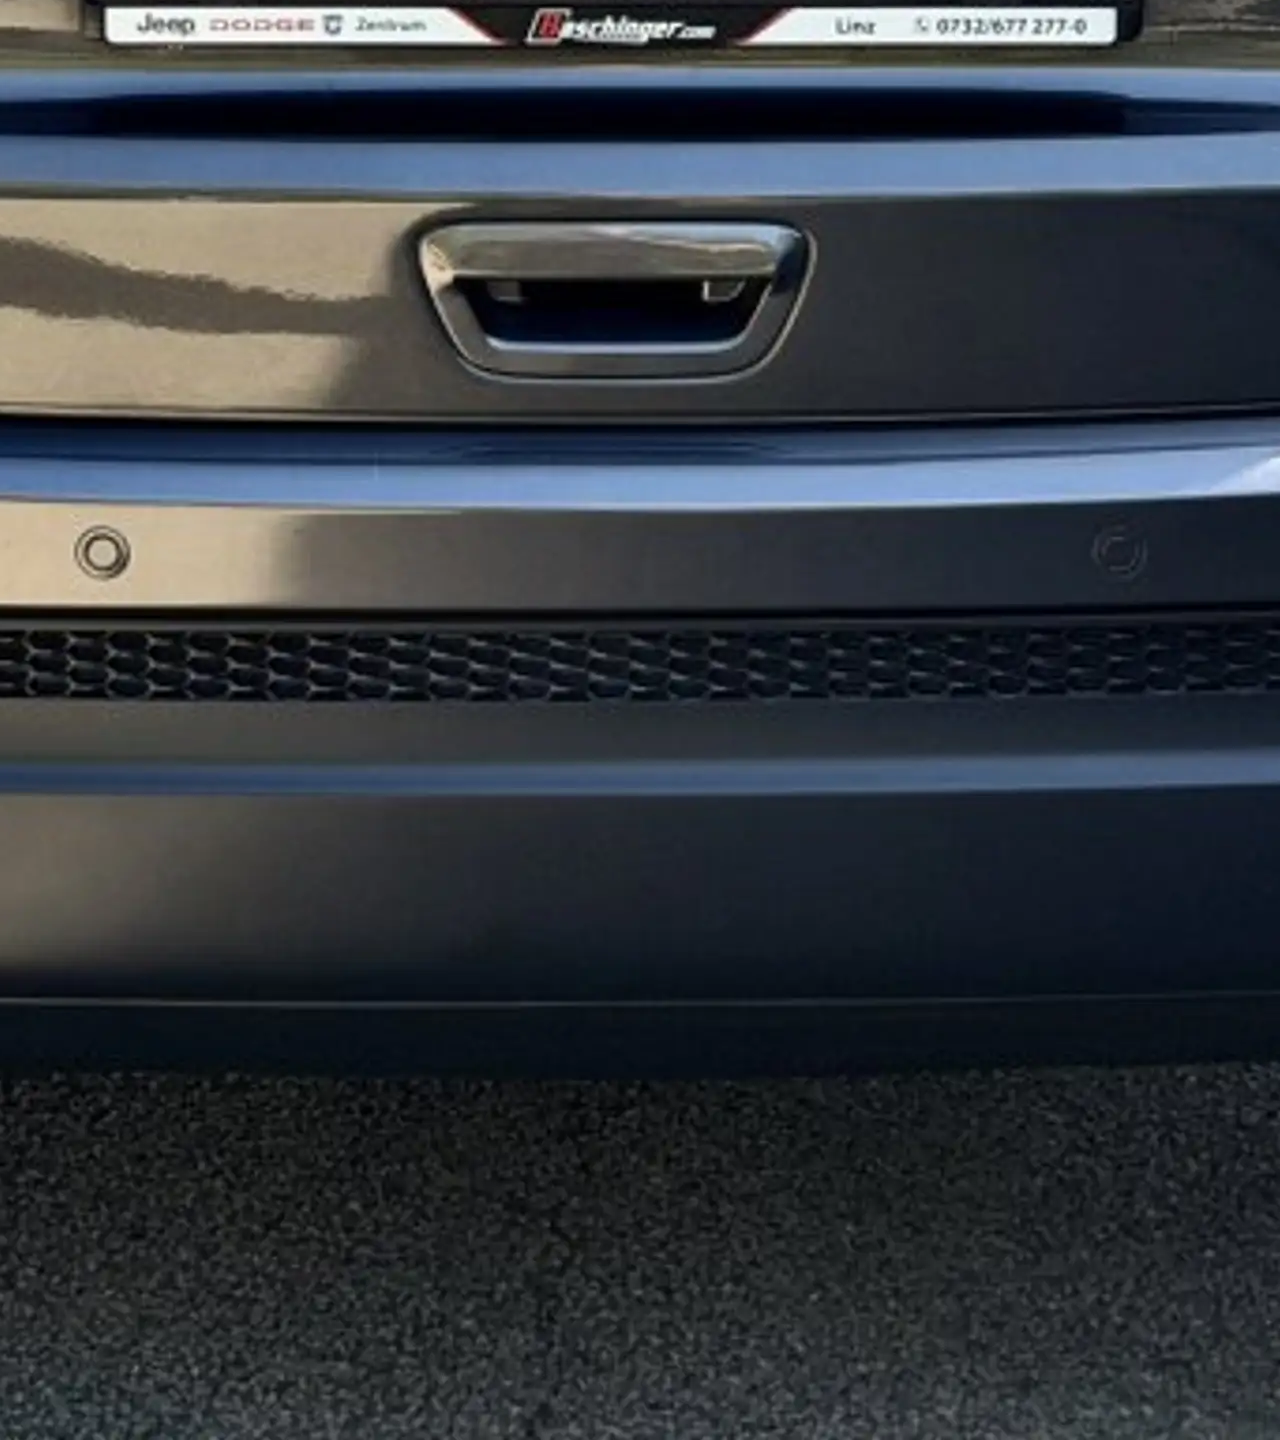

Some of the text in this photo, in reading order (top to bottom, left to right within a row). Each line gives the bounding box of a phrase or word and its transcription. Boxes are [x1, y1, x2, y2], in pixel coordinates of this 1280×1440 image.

[137, 12, 427, 35] Jeep DODGE Zentrum
[834, 19, 876, 35] Linz
